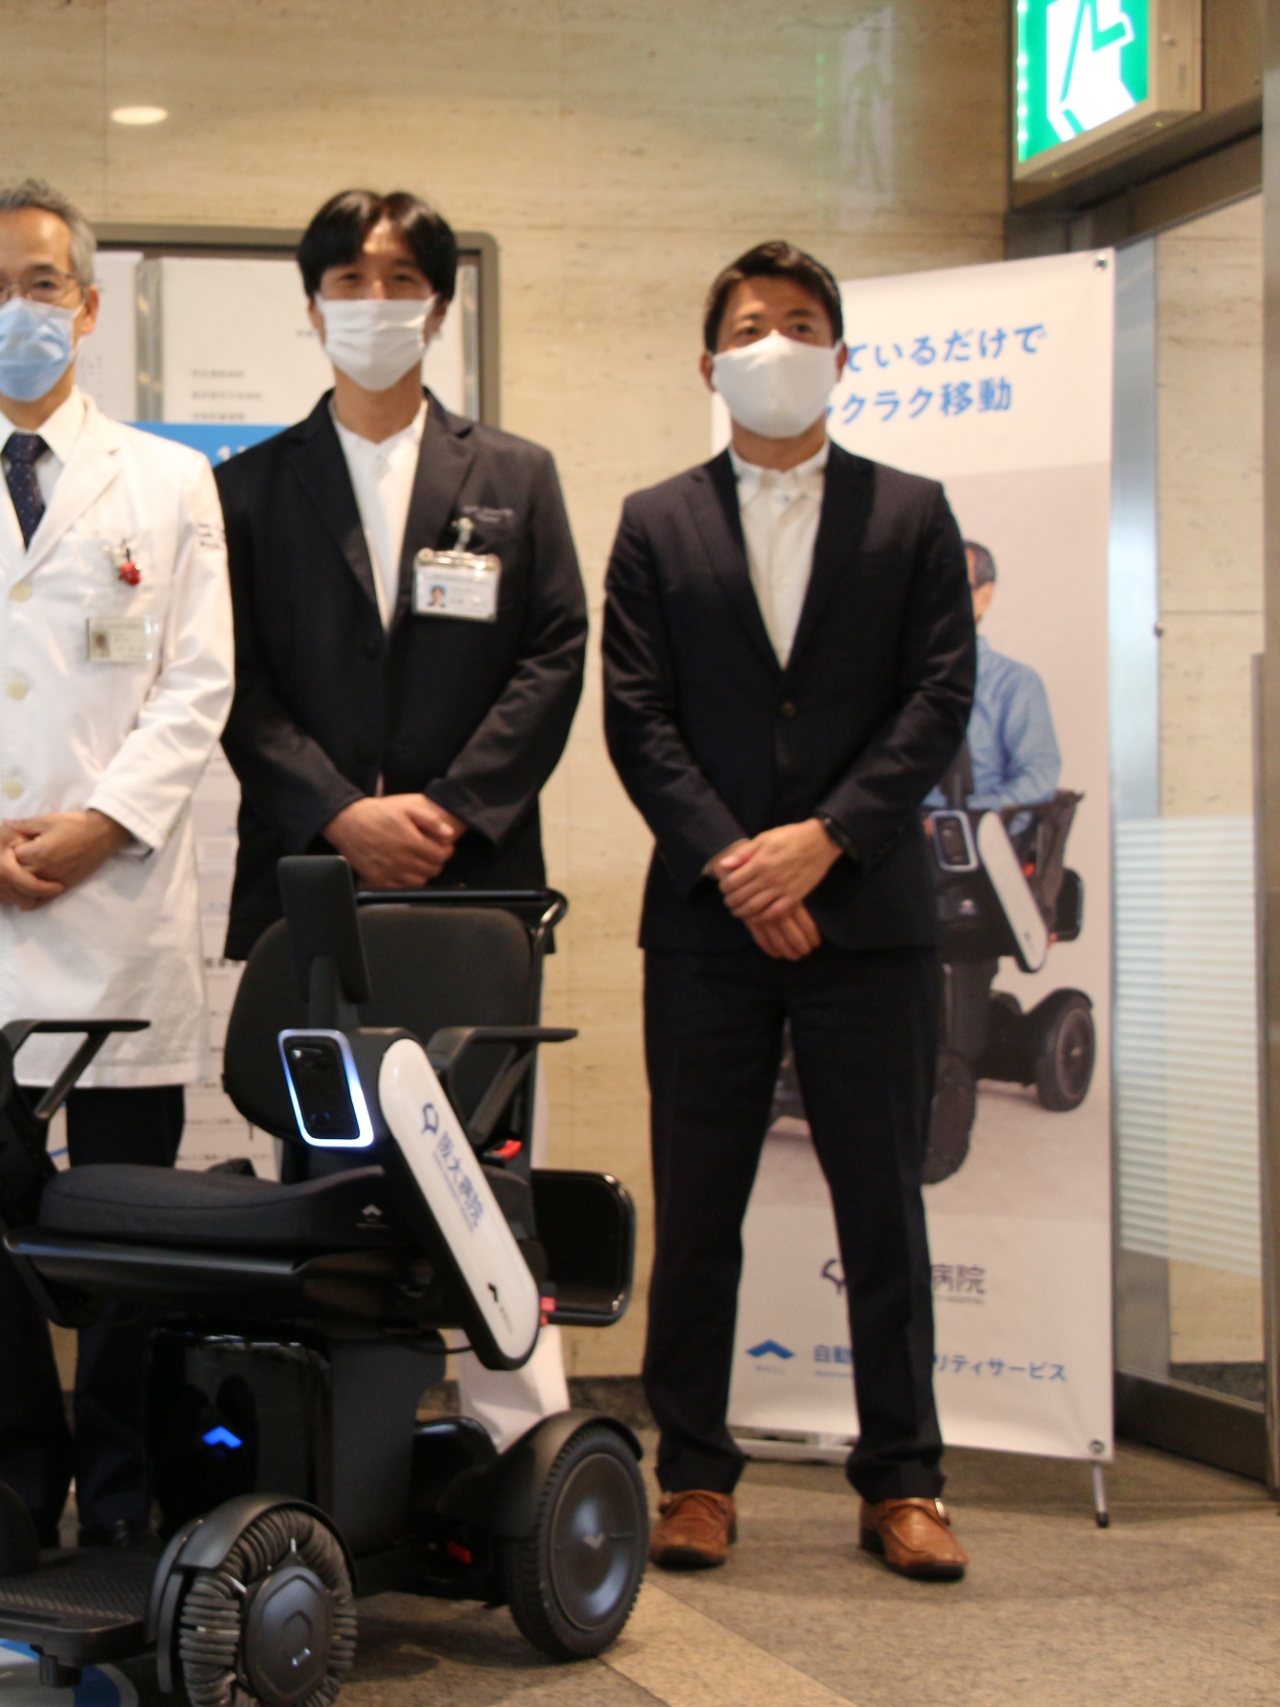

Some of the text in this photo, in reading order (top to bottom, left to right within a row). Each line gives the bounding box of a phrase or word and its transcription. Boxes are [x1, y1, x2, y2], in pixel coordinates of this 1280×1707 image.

[847, 323, 1046, 372] ているだけで
[823, 376, 1013, 425] クラク移動
